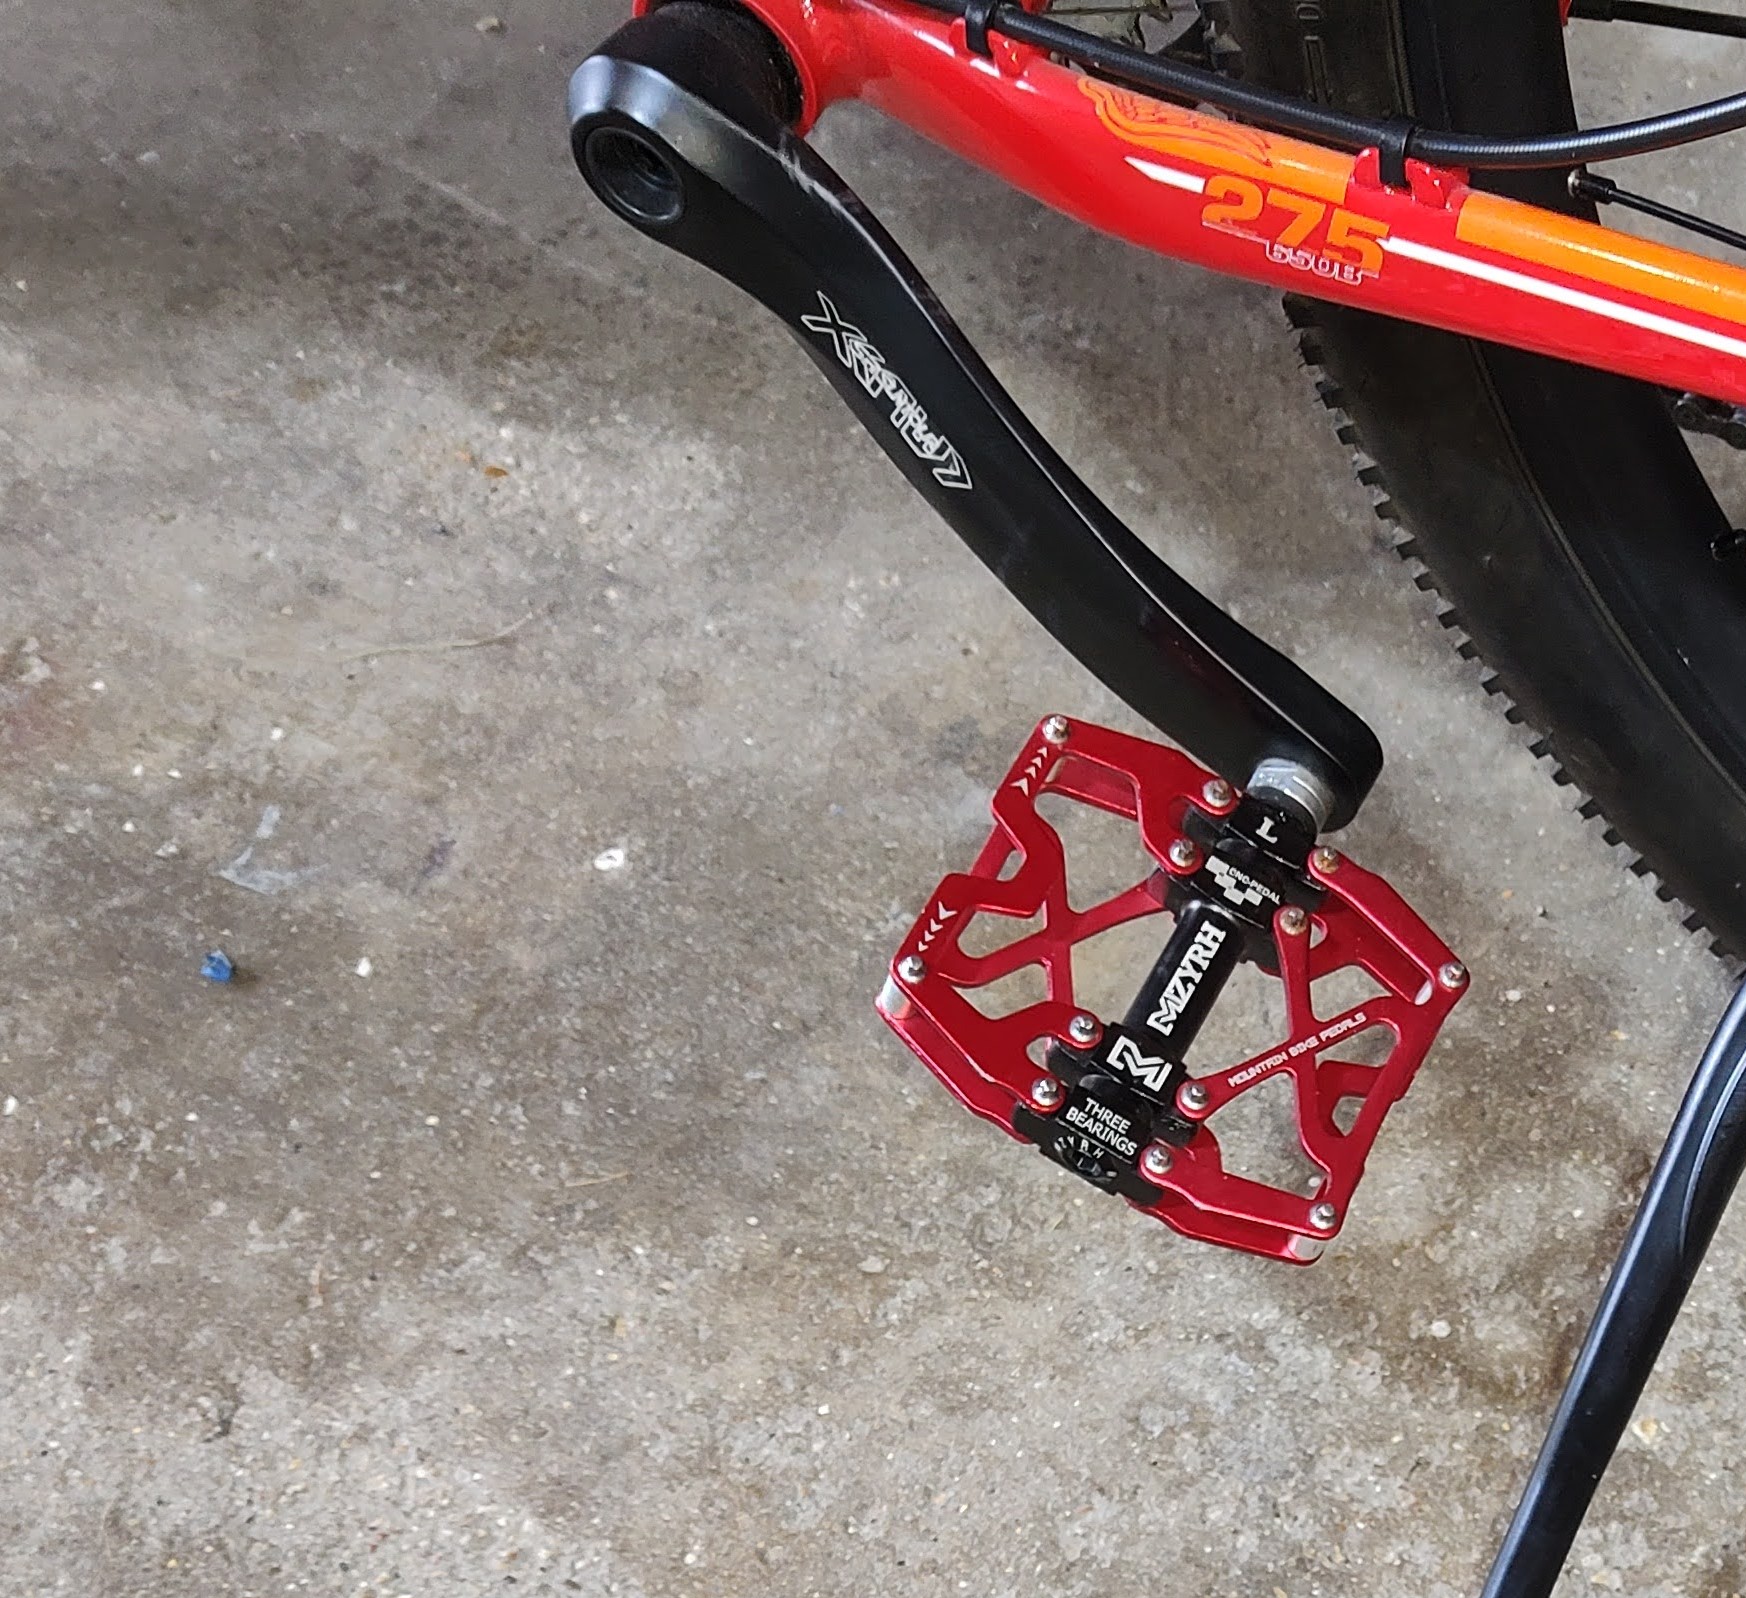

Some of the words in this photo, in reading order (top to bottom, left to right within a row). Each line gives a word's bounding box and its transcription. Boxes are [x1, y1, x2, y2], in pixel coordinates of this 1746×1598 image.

[1202, 175, 1390, 278] 275
[1255, 816, 1278, 844] L
[1146, 920, 1227, 1037] MZYRH
[1227, 1051, 1289, 1088] MOUNTAIN
[1288, 1036, 1320, 1057] BIKE
[1319, 1011, 1368, 1042] PEDALS
[1065, 1106, 1138, 1156] BEARINGS
[1084, 1097, 1132, 1135] THREE
